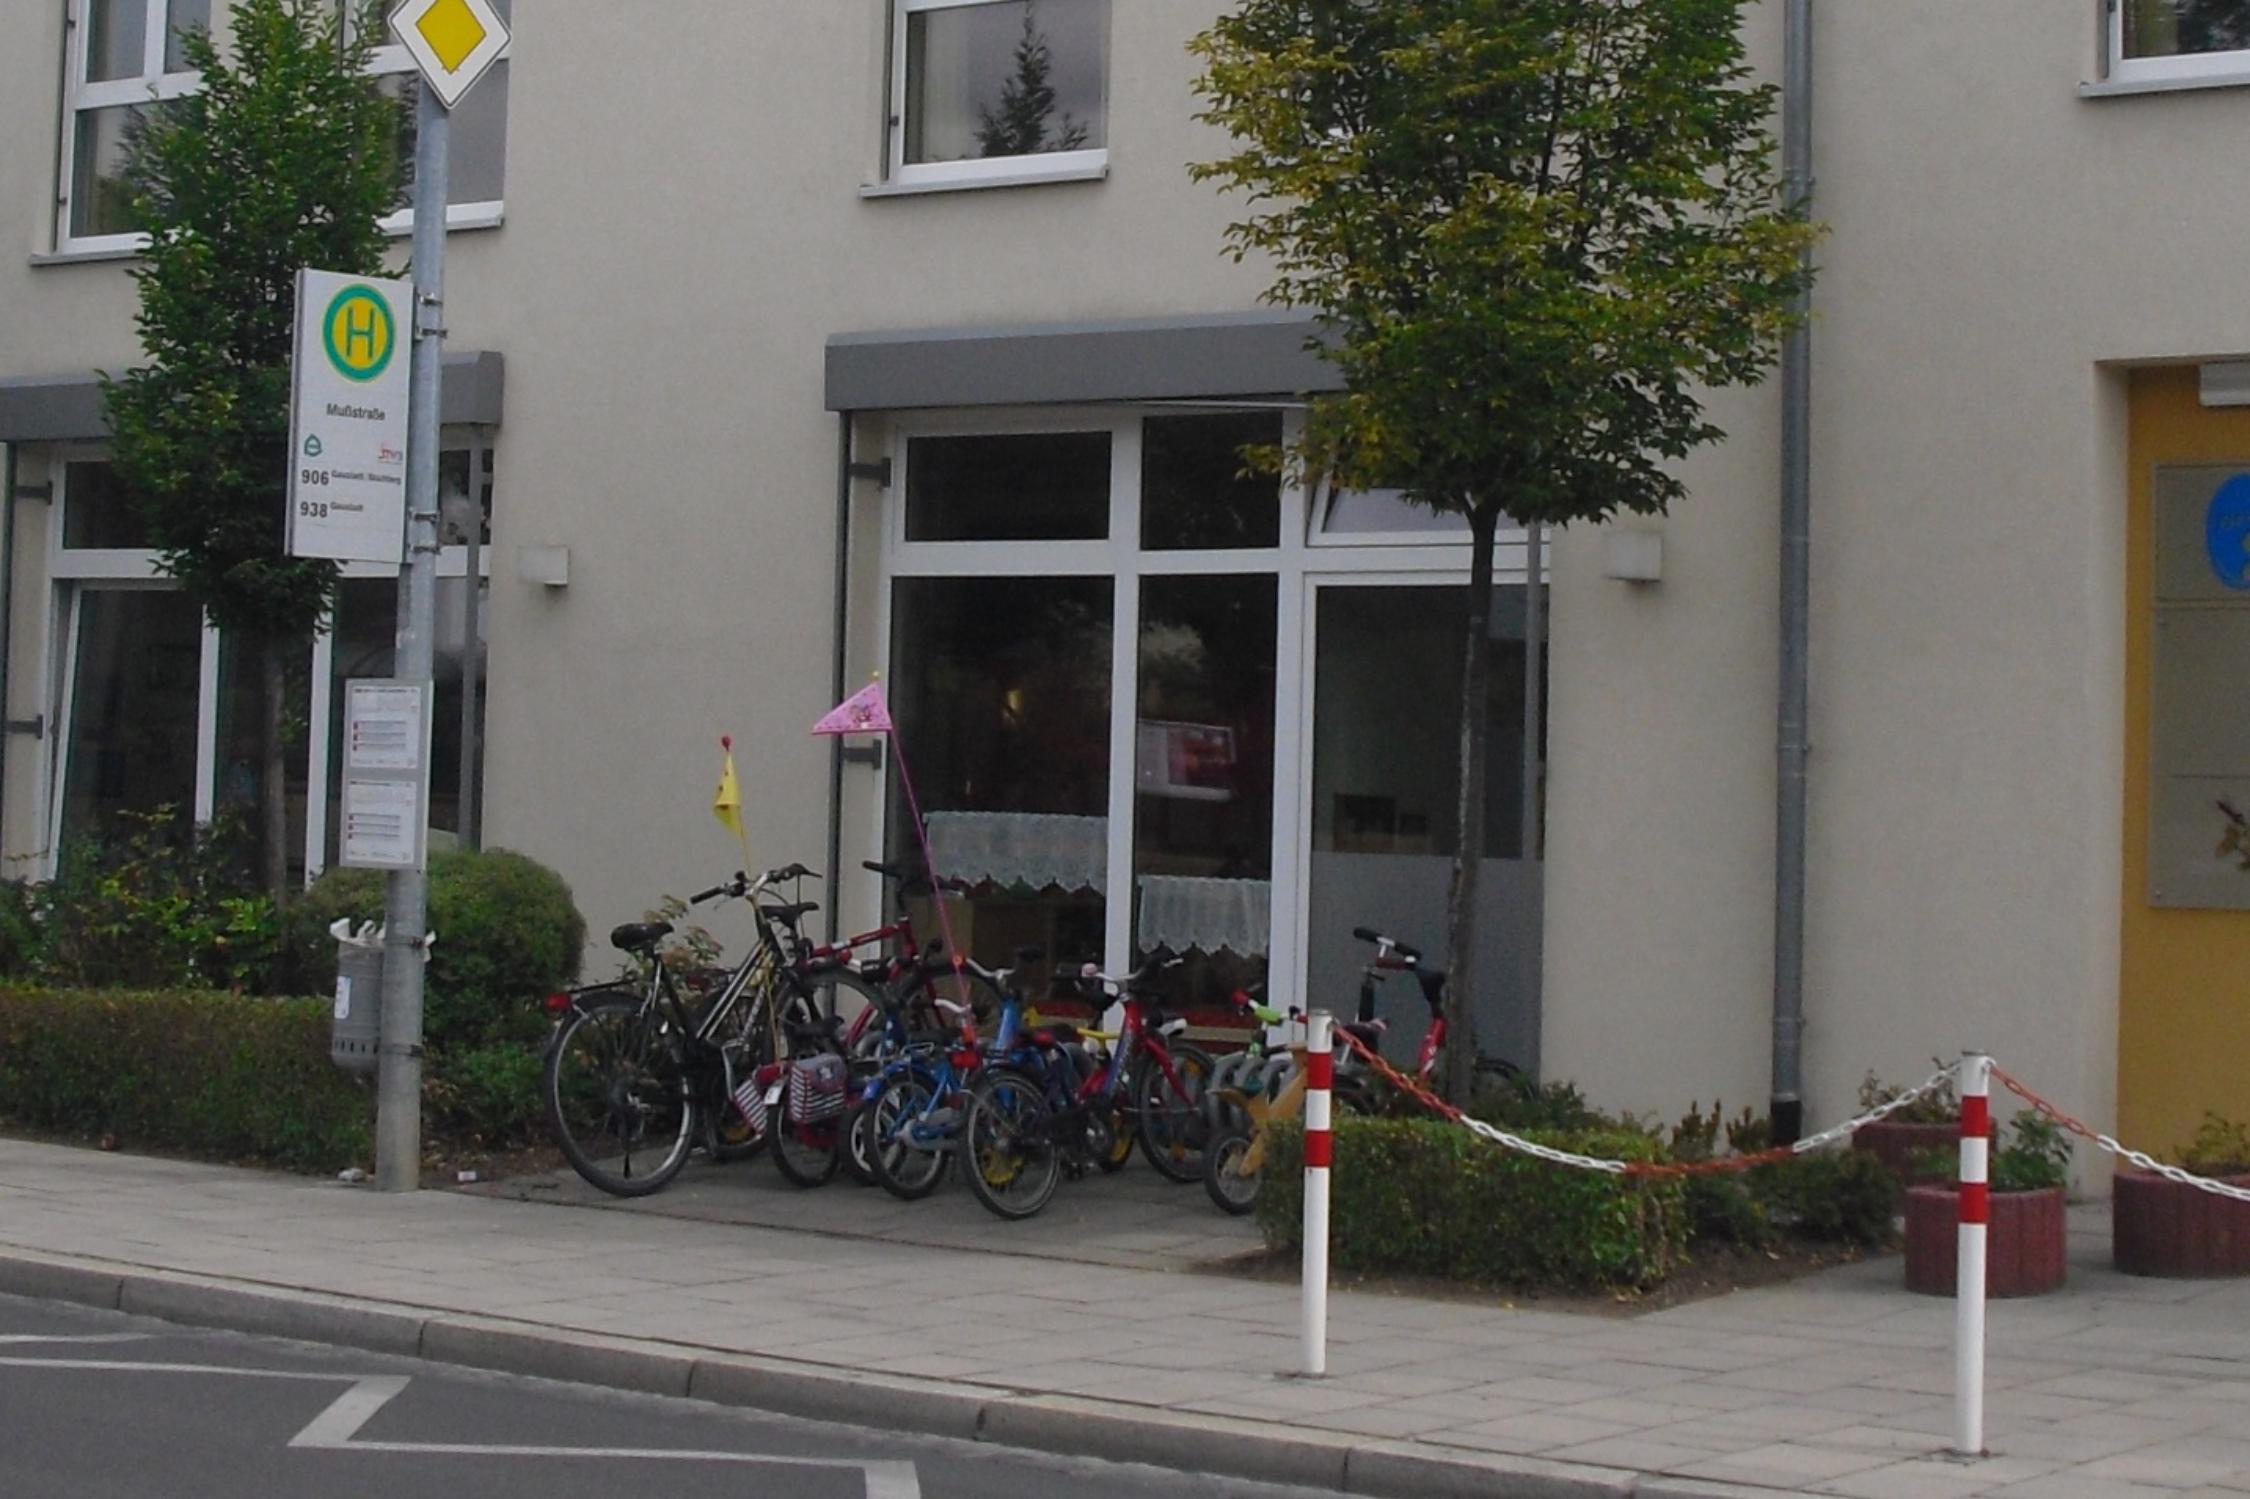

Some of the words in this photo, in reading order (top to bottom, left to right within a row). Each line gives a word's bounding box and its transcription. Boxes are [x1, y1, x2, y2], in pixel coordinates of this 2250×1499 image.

[346, 306, 375, 358] H
[326, 403, 386, 420] Mußstraße
[301, 469, 329, 486] 906
[300, 501, 328, 518] 938
